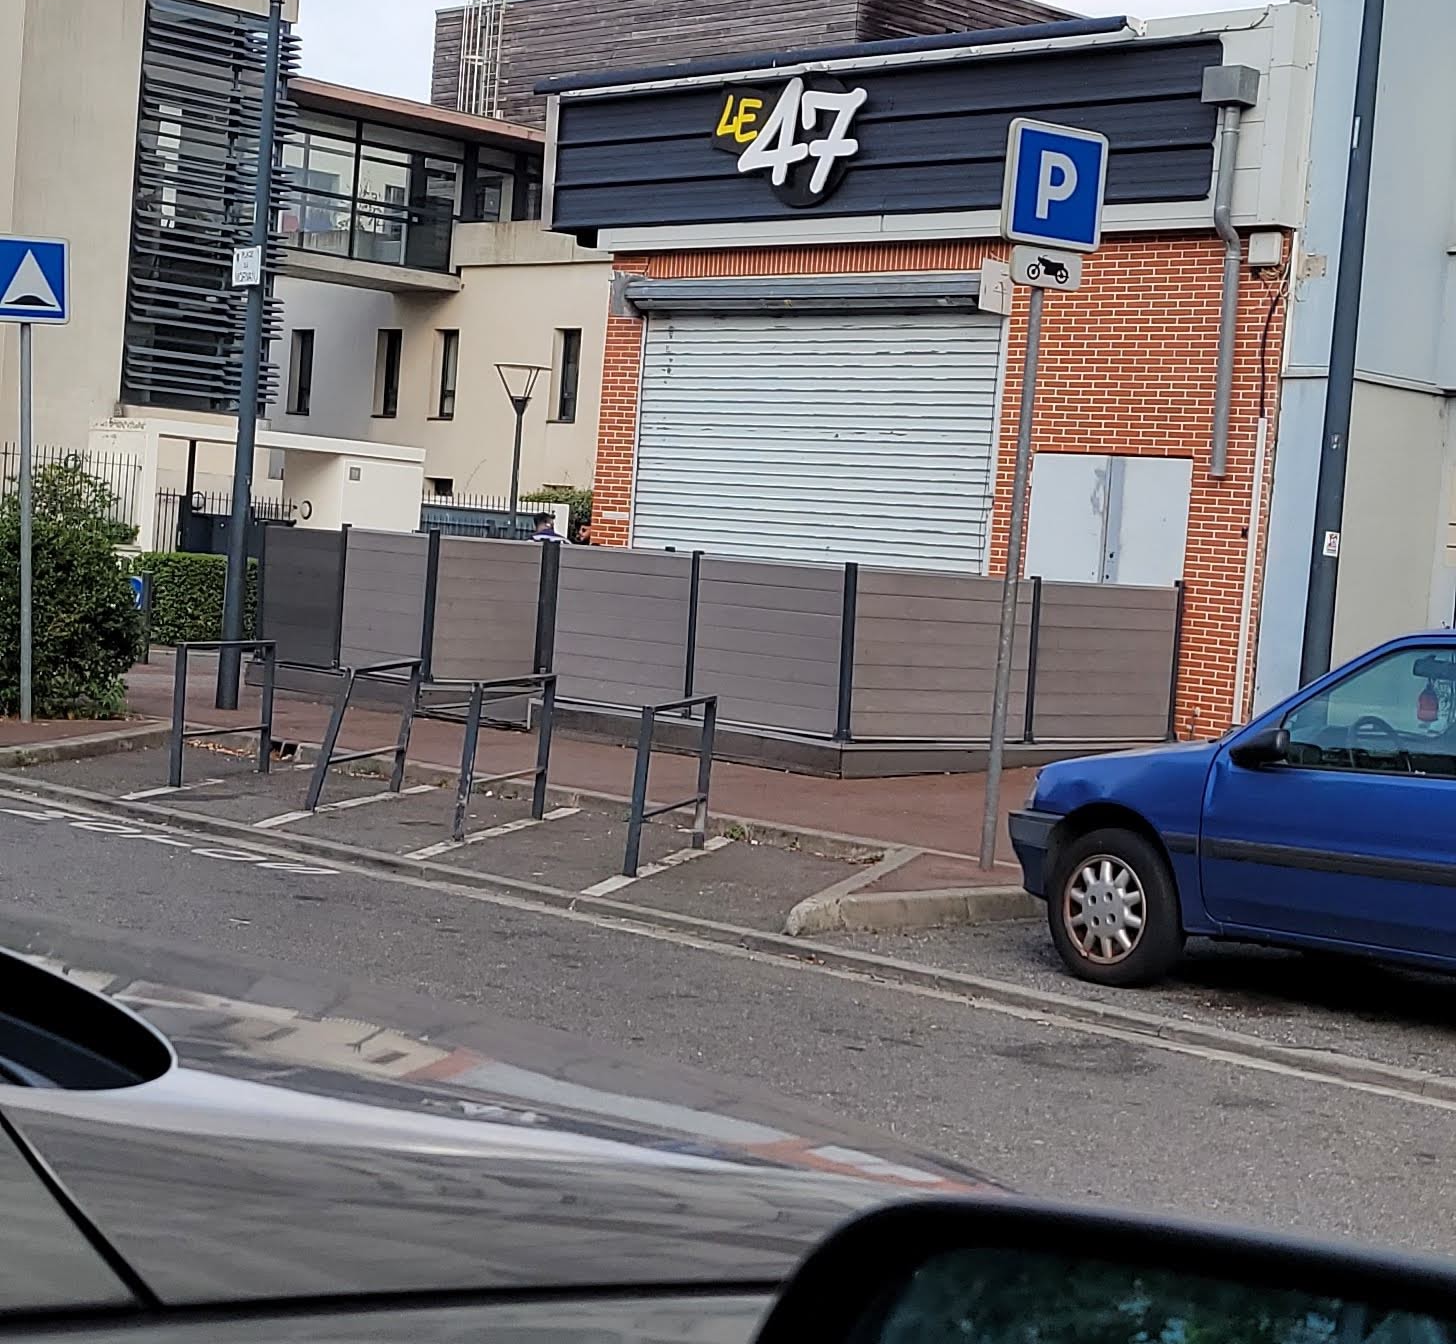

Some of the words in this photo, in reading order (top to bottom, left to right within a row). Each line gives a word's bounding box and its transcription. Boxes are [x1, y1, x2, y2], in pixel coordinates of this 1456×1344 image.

[716, 94, 763, 143] LE
[737, 77, 868, 194] 47
[1035, 150, 1078, 220] P
